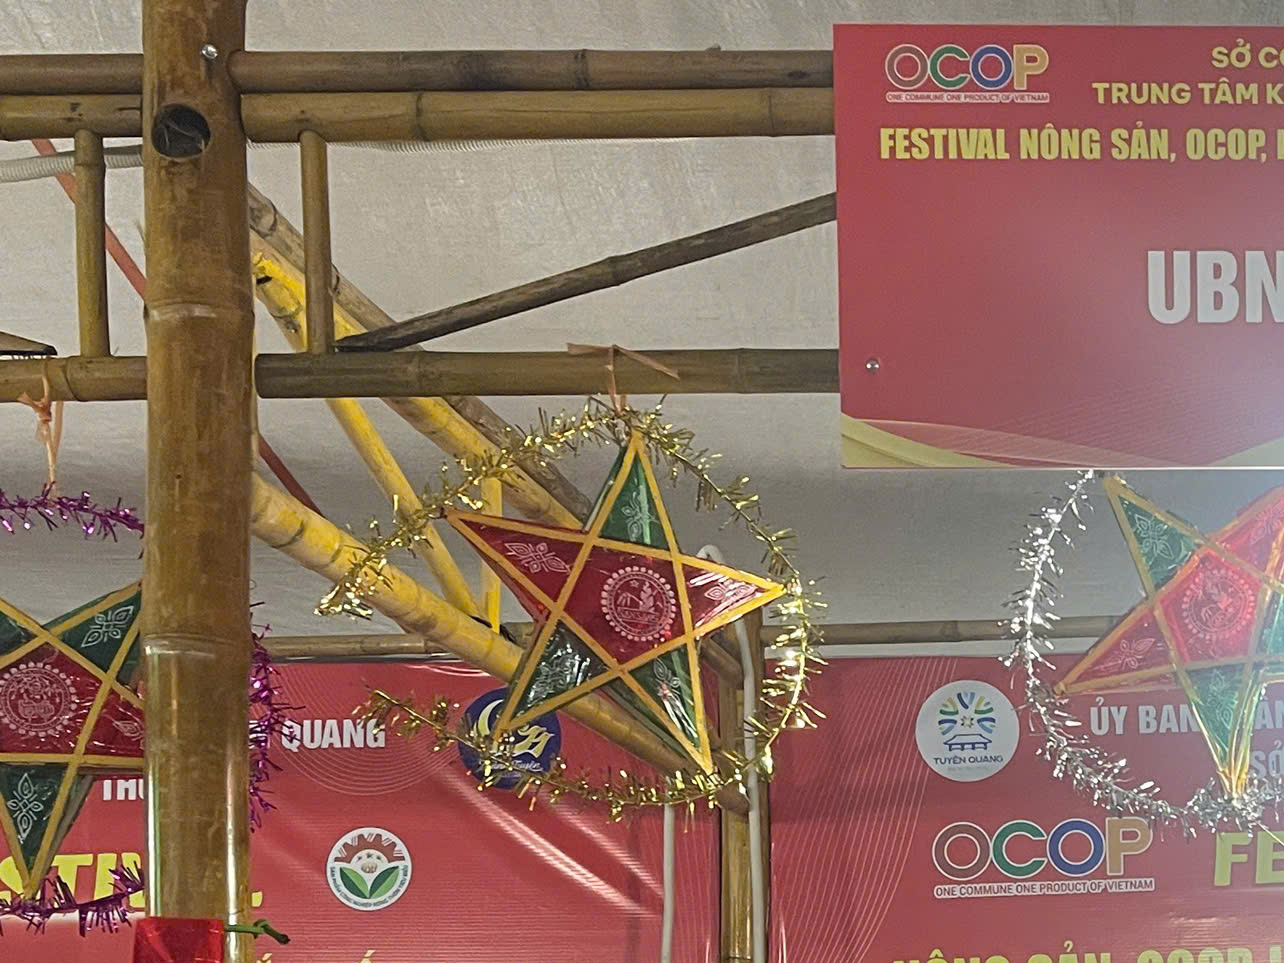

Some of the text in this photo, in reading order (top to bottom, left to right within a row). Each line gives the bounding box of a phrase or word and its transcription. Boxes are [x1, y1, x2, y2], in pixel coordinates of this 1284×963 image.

[885, 43, 1048, 90] OCOP
[1211, 39, 1252, 69] SỞ
[1093, 82, 1191, 105] TRUNG
[1198, 77, 1258, 105] TÂM
[880, 128, 1009, 159] FESTIVAL
[1020, 123, 1100, 160] NÔNG
[1111, 121, 1176, 164] SẢN,
[1187, 128, 1267, 163] OCOP,
[1091, 697, 1127, 735] ỦY
[1139, 705, 1200, 733] BAN
[282, 718, 385, 752] QUANG
[934, 754, 1003, 765] TUYÊN QUANG
[932, 817, 1153, 880] OCOP
[935, 880, 1153, 897] ONE COMMUNE ONE PRODUCT OF VIETNAM
